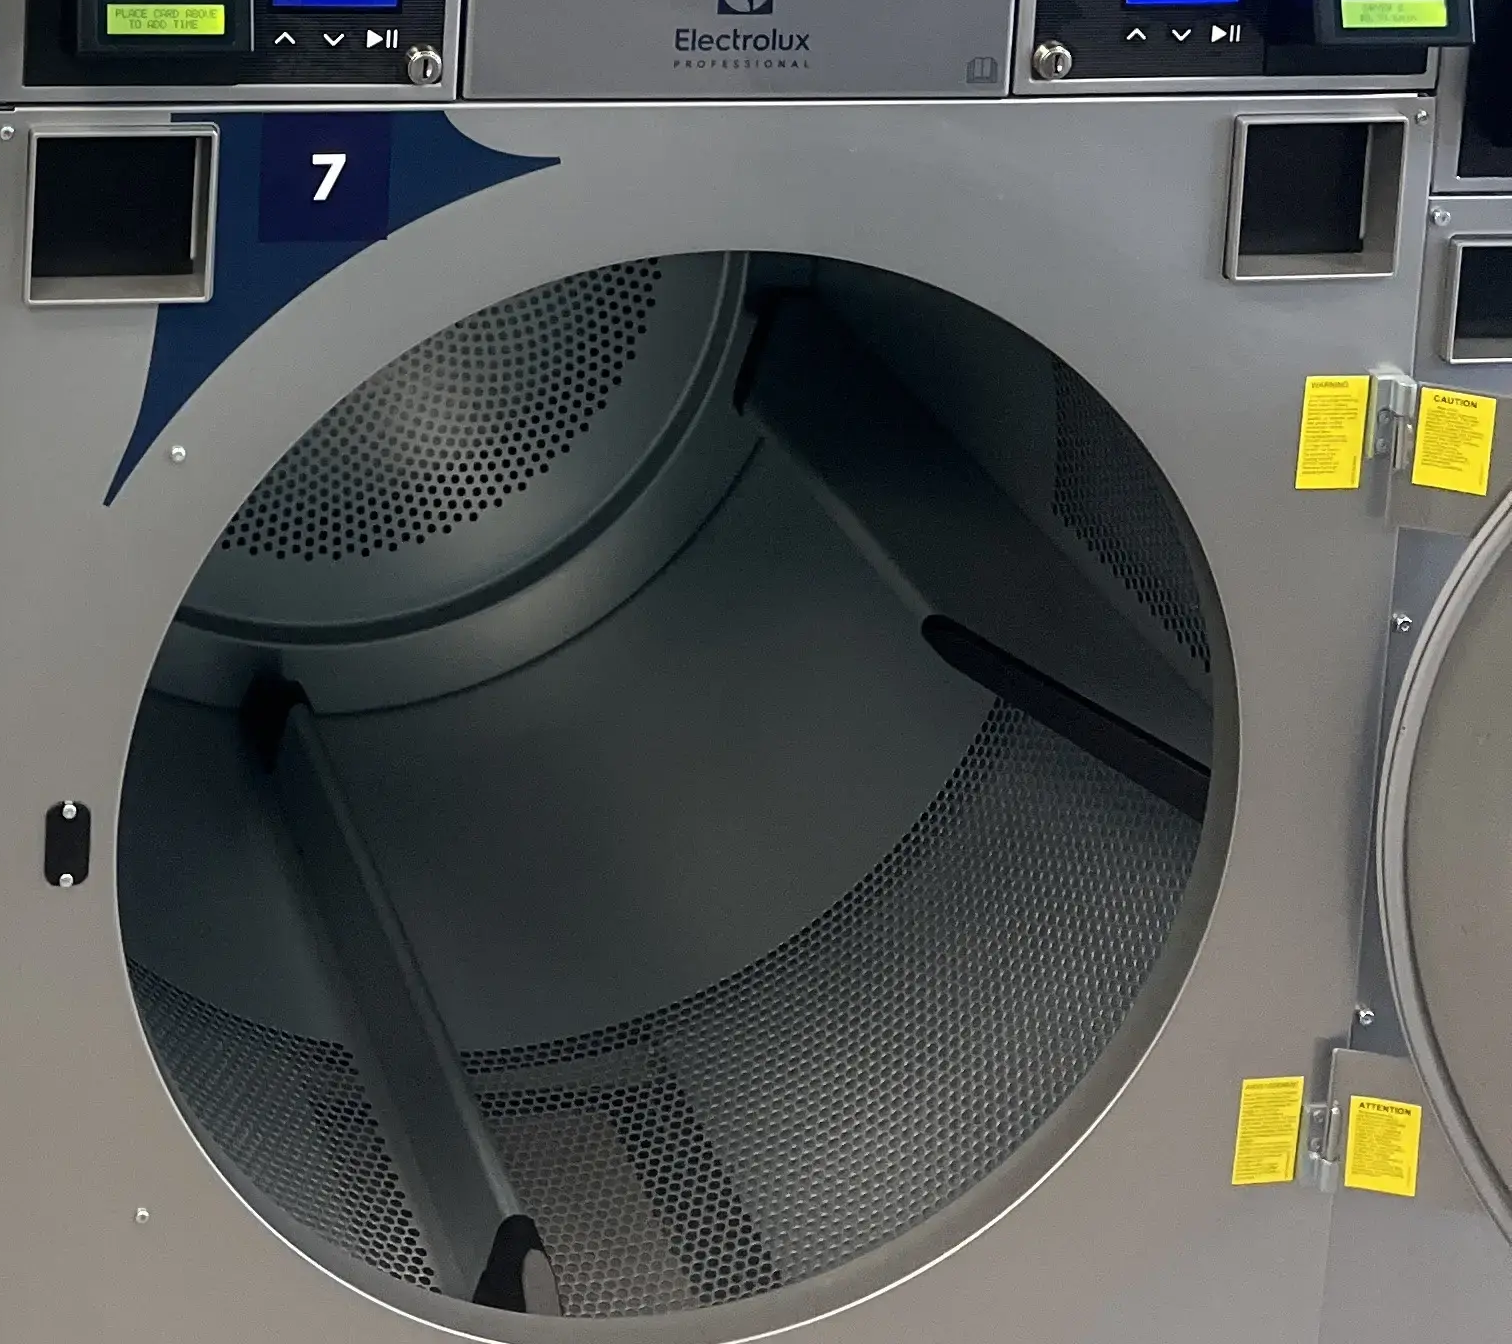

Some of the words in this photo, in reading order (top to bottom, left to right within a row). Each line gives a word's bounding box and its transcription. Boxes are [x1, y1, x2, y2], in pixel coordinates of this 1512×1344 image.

[115, 8, 147, 18] PLACE
[153, 8, 179, 18] CARD
[186, 8, 218, 18] ABOVE
[129, 20, 141, 29] TO
[147, 20, 167, 29] ADD
[174, 20, 198, 29] TIME
[675, 28, 809, 51] Electrolux
[673, 59, 810, 69] PROFESSIONAL
[311, 153, 347, 201] 7
[1433, 394, 1477, 408] CAUTION
[1359, 1102, 1411, 1116] ATTENTION
